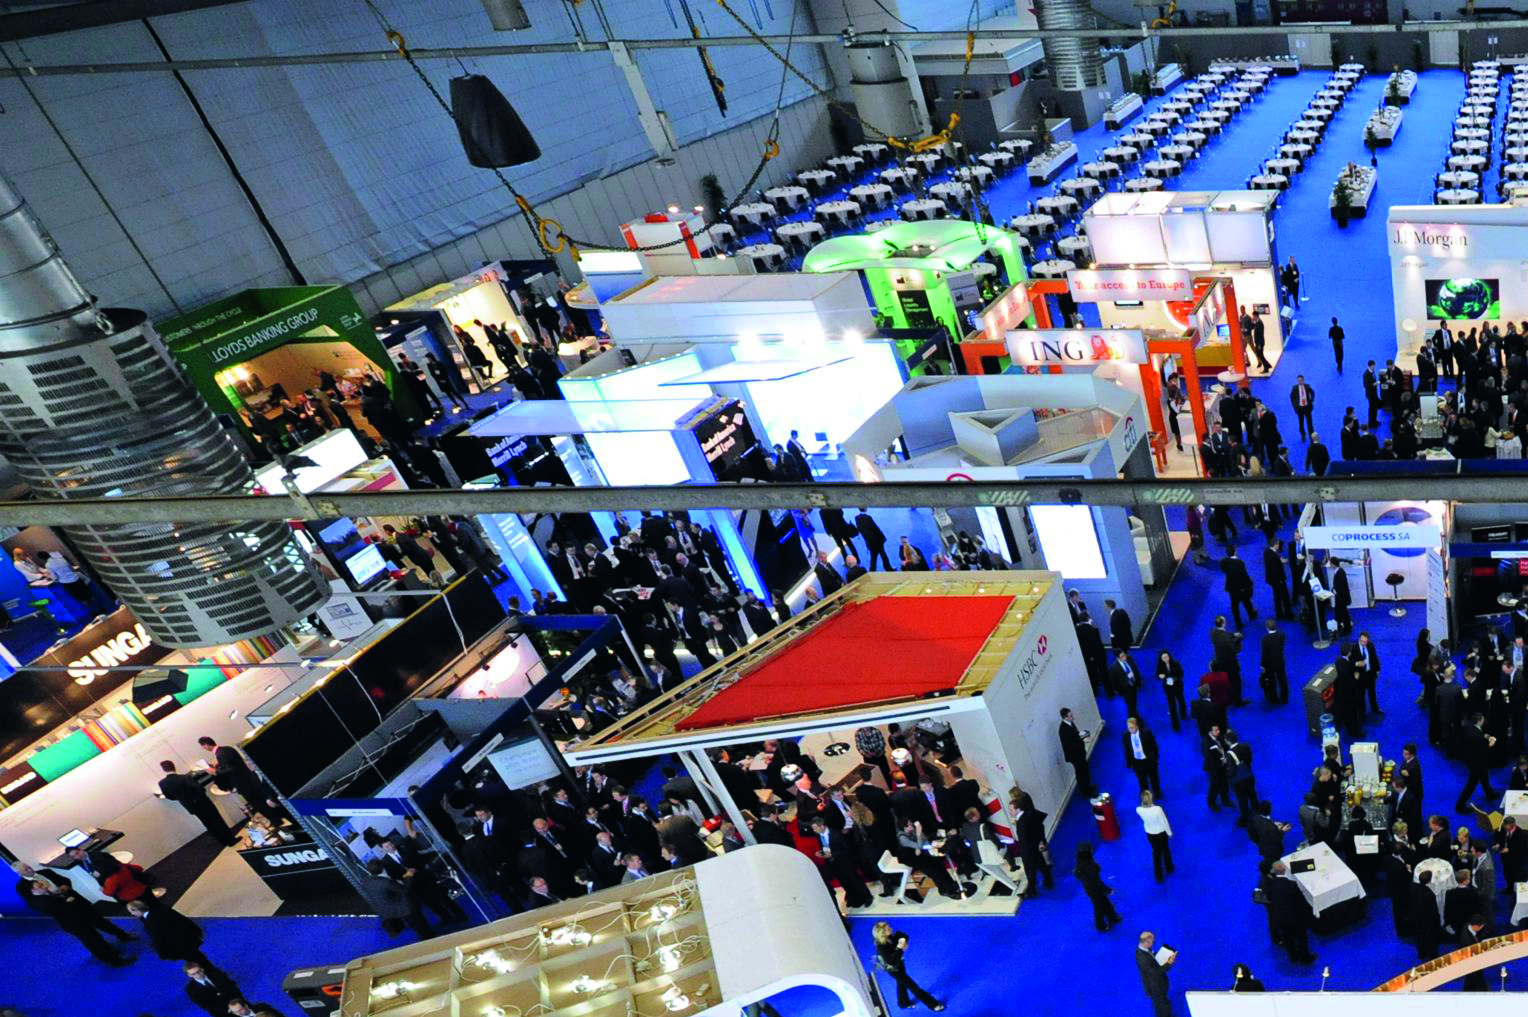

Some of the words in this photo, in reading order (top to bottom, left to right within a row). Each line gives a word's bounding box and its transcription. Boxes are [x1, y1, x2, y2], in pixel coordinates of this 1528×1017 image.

[210, 338, 247, 363] LOYDS
[246, 322, 290, 348] BANKING
[288, 308, 319, 332] GROUP
[1031, 340, 1084, 361] ING
[1332, 532, 1396, 542] COPROCESS
[1398, 532, 1410, 541] SA
[67, 622, 152, 686] SUNGA
[1017, 649, 1039, 690] HSBC
[264, 848, 330, 867] SUNGA
